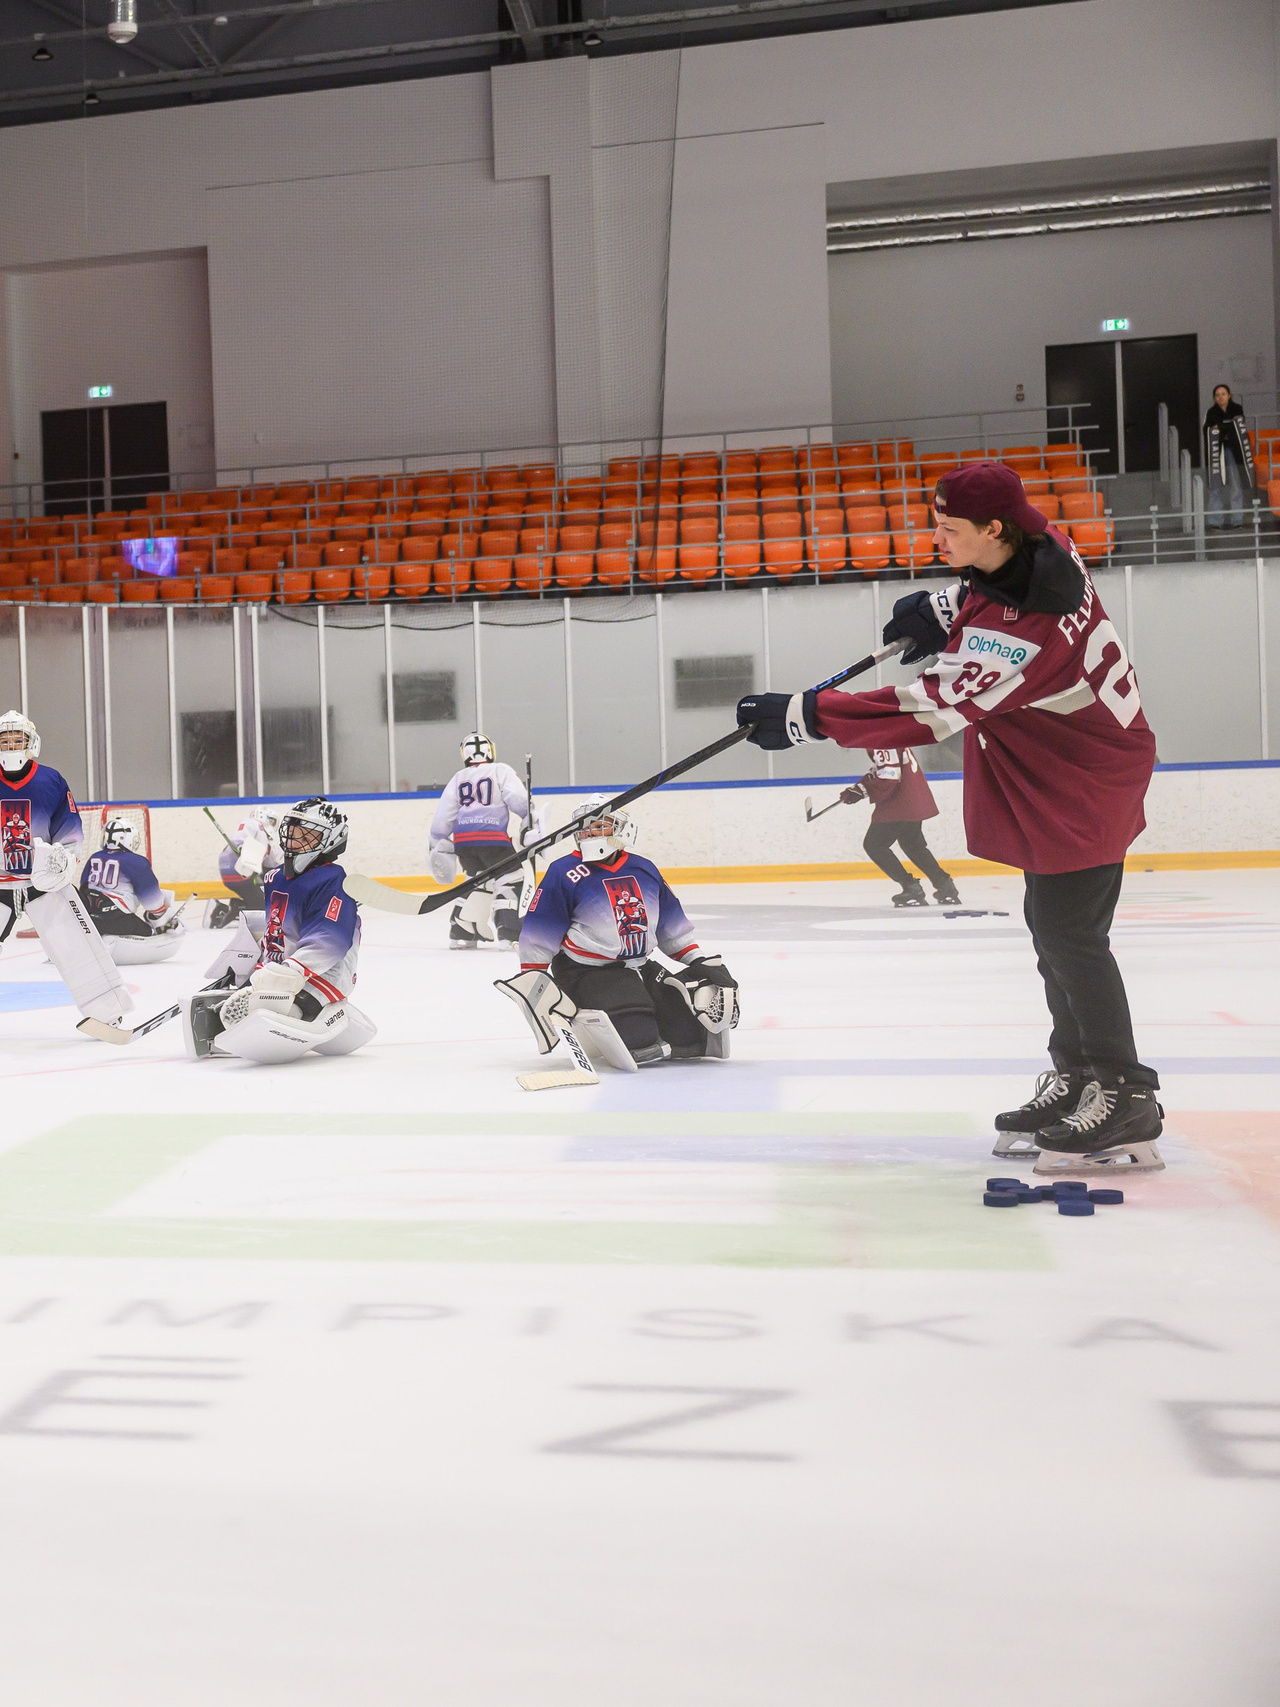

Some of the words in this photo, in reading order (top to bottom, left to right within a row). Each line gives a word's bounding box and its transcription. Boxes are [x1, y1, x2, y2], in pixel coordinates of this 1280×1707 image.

[968, 635, 1011, 660] Olpha
[951, 661, 1001, 698] 29
[876, 750, 891, 763] 30
[458, 777, 493, 807] 80
[88, 858, 120, 890] 80
[566, 864, 591, 883] 80
[101, 904, 118, 913] CC
[521, 884, 533, 909] CCM
[69, 900, 92, 935] BAUER
[656, 967, 667, 983] CCM
[324, 1009, 345, 1027] BAUER
[561, 1028, 593, 1073] BAUER
